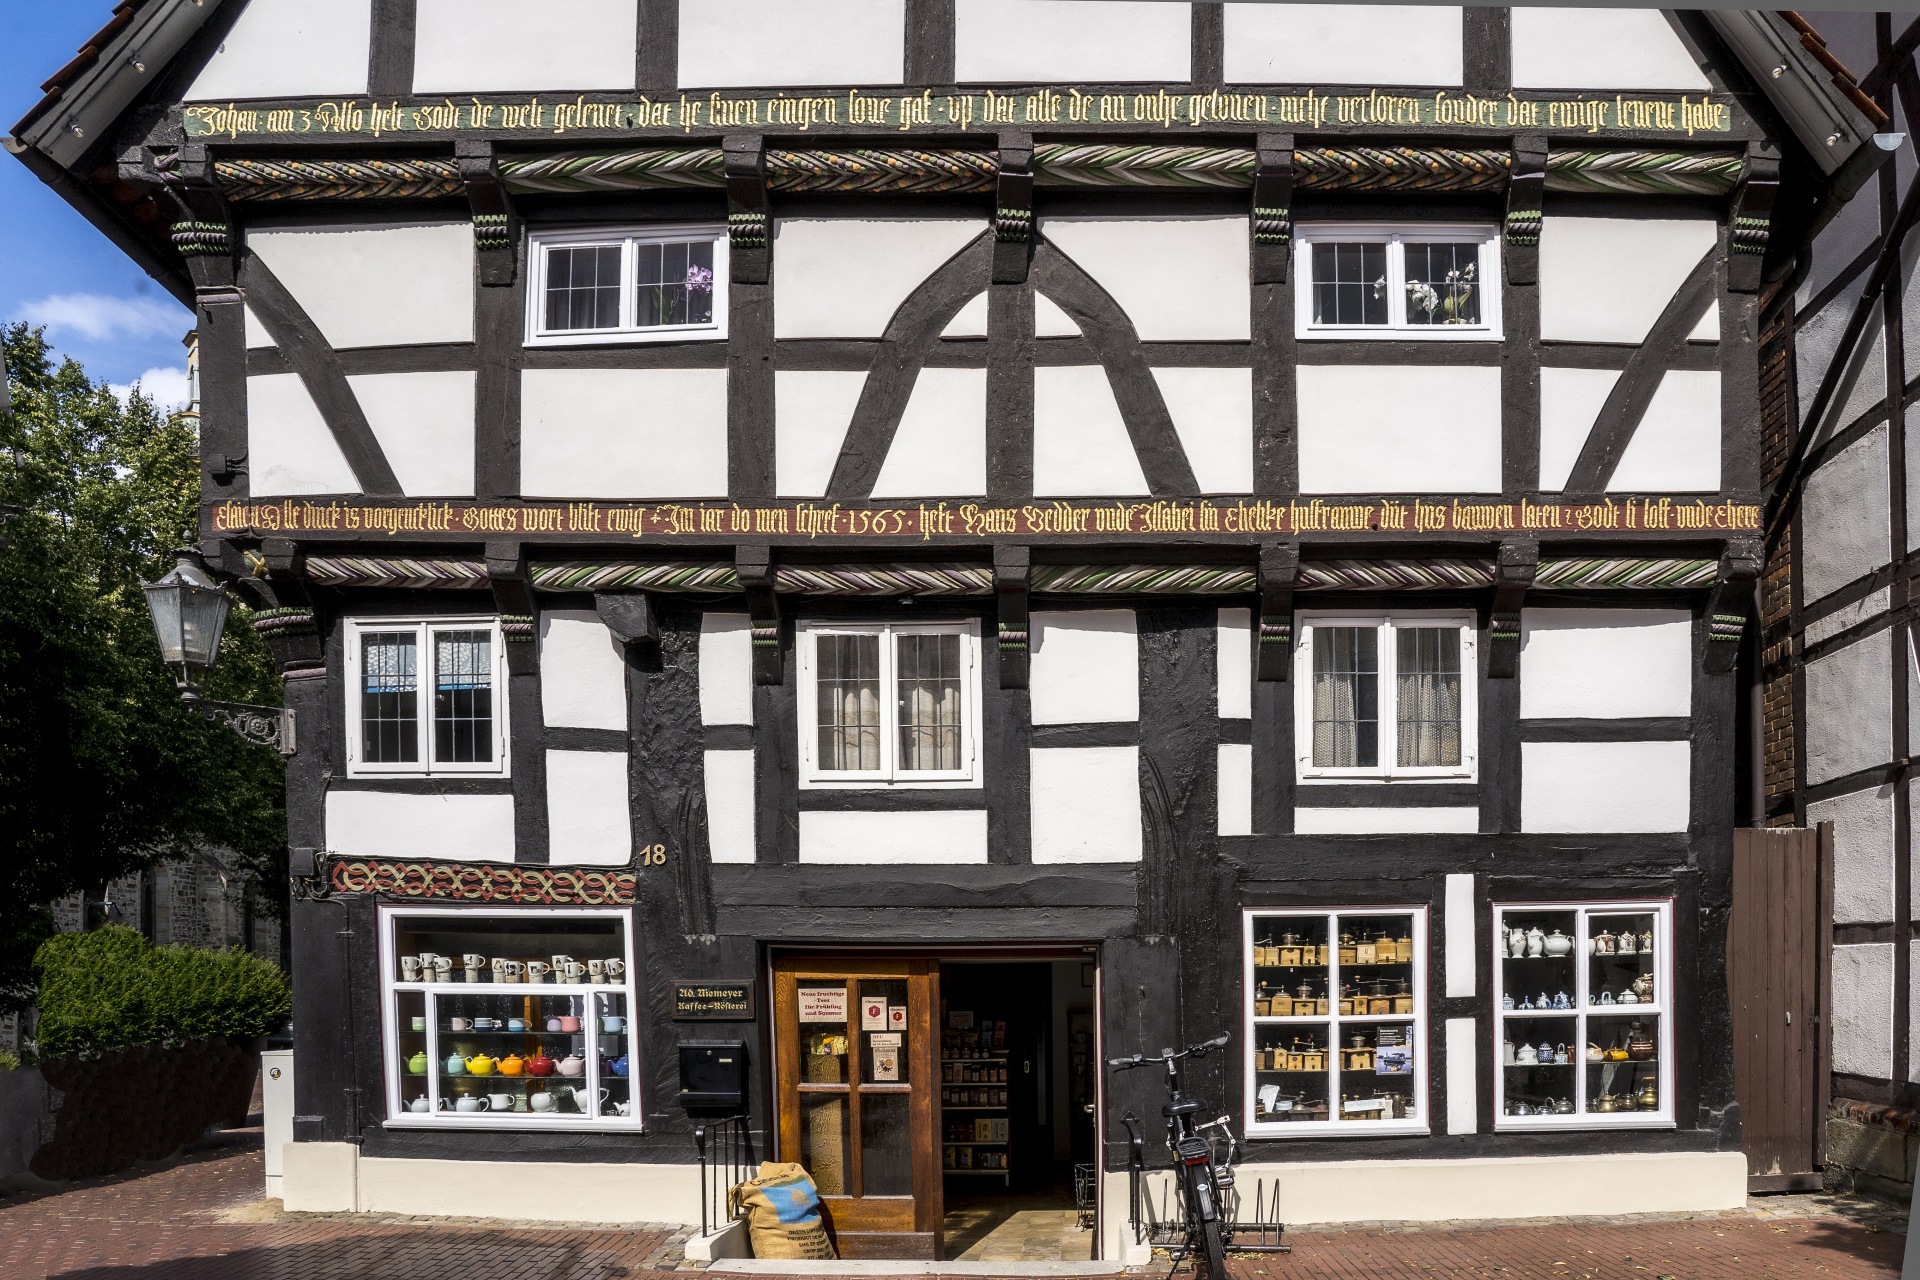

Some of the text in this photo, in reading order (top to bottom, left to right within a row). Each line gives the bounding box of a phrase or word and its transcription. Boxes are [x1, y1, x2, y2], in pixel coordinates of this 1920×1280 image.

[470, 97, 494, 132] de
[636, 95, 672, 128] dat
[983, 89, 1016, 124] dat
[1025, 88, 1062, 124] alle
[1068, 87, 1094, 124] de
[1505, 92, 1540, 128] dat
[343, 501, 360, 531] is
[848, 509, 906, 535] 1565
[639, 843, 666, 866] 18
[698, 989, 743, 999] Niemeyer
